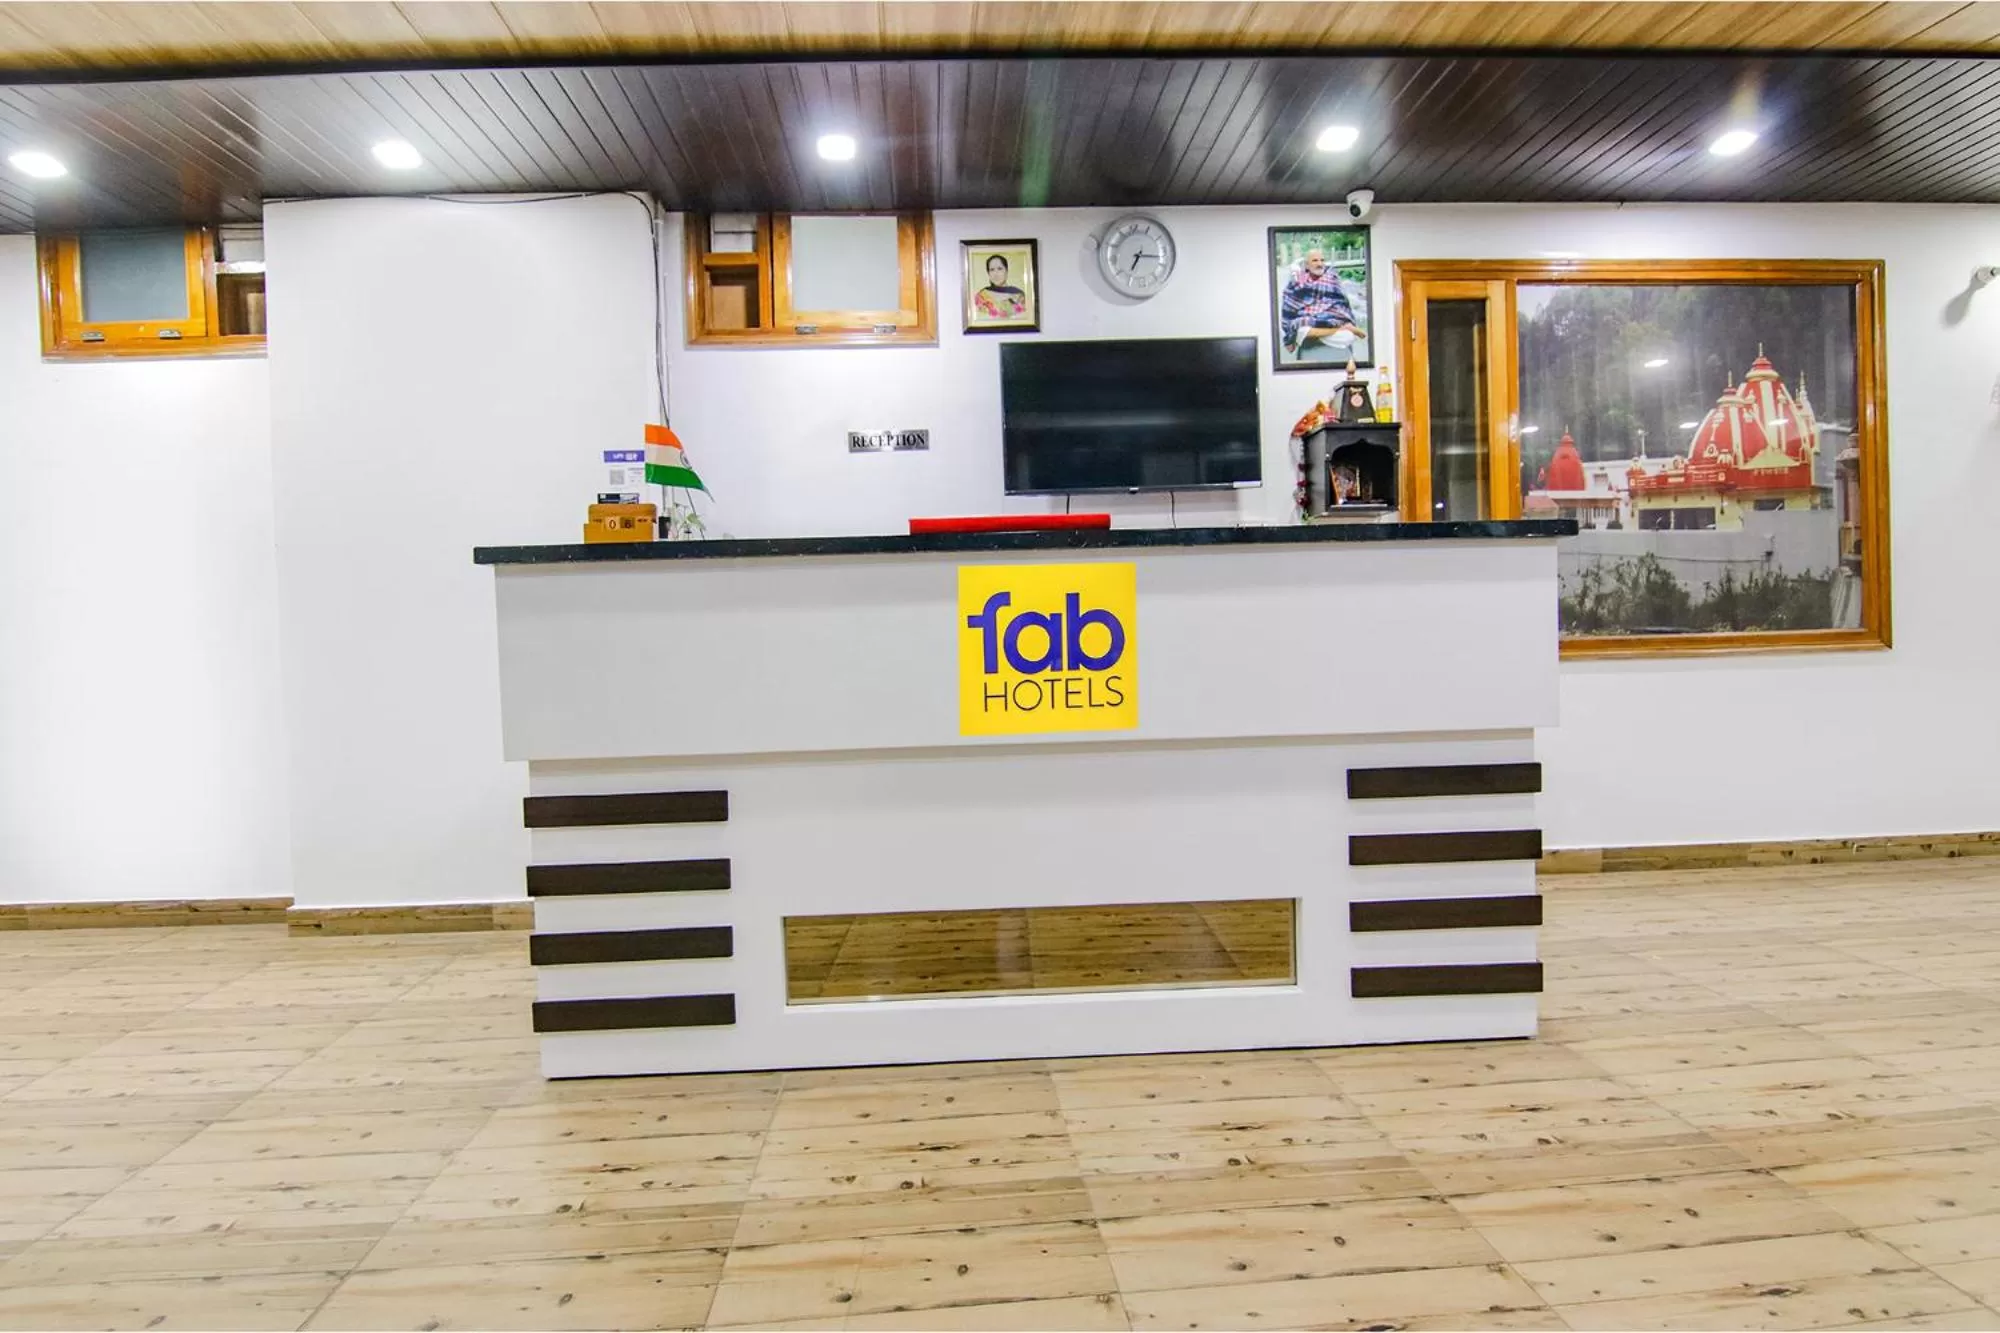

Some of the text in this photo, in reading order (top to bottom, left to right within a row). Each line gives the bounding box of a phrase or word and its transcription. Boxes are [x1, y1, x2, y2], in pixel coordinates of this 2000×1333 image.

[852, 432, 926, 449] RECEPTION
[967, 591, 1126, 675] fab
[983, 675, 1125, 712] HOTELS
